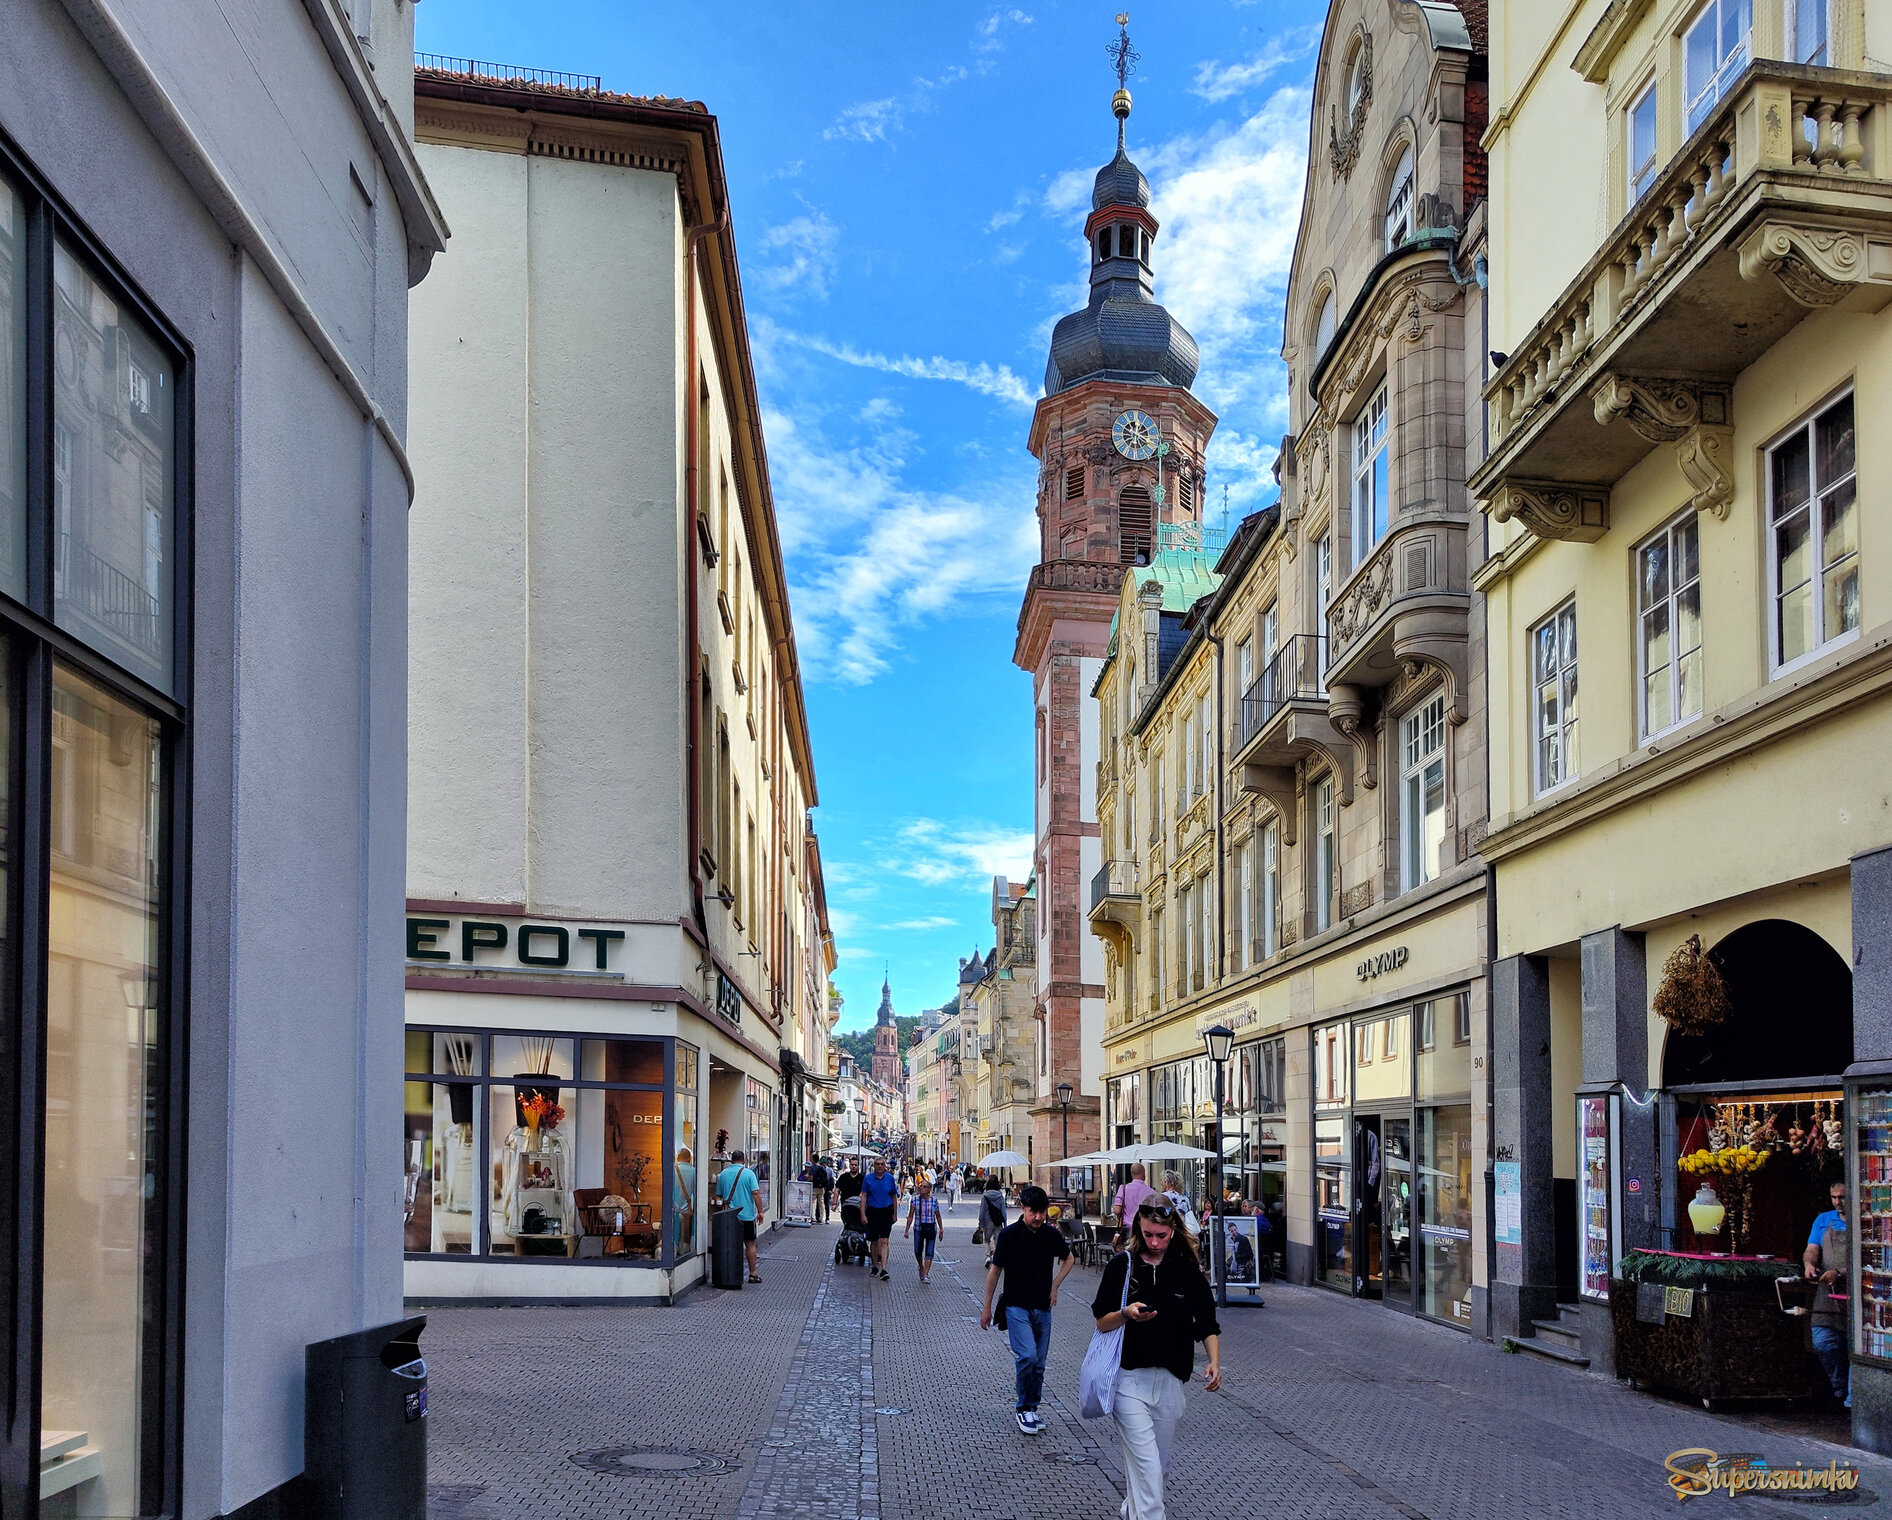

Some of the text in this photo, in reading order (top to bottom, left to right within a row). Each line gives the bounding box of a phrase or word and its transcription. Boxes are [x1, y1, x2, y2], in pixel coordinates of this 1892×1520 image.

[406, 917, 626, 970] EPOT
[1356, 945, 1409, 983] OLYMP
[720, 975, 742, 1022] DEPOT
[1474, 1056, 1484, 1069] 90
[1434, 1235, 1455, 1247] OLYMP
